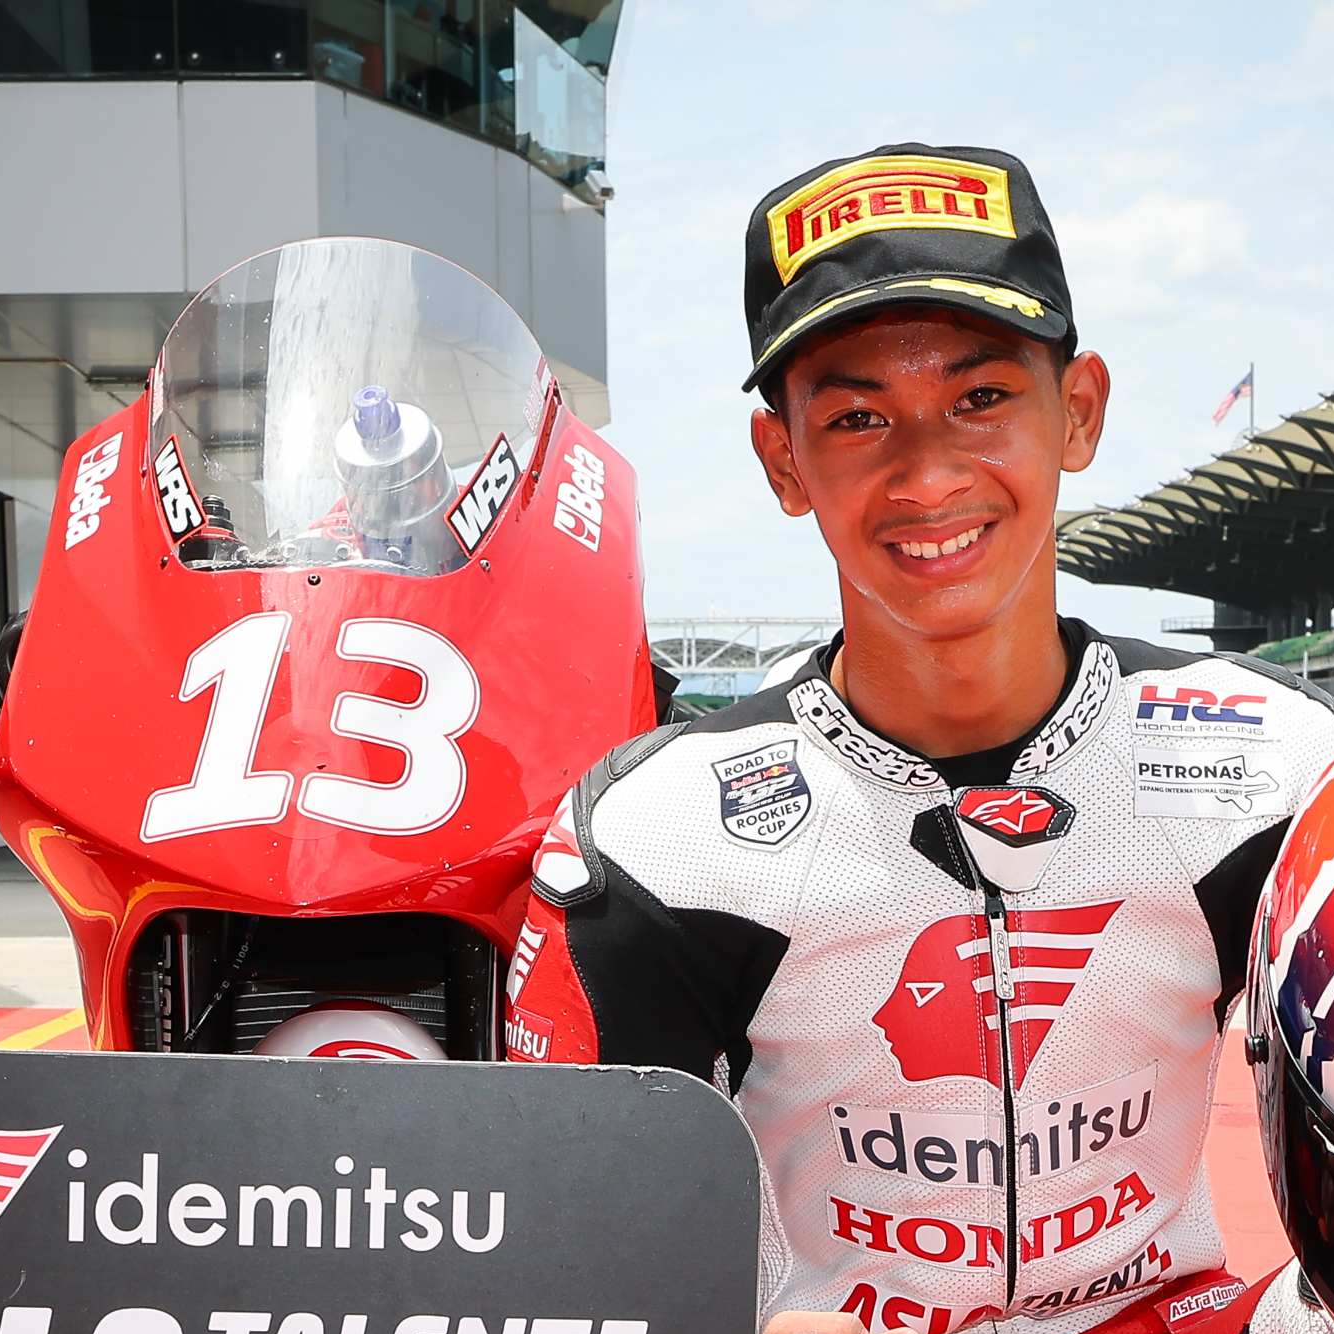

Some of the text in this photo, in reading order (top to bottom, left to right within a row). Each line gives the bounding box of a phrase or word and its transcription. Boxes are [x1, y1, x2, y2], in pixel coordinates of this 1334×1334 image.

[784, 168, 988, 258] PIRELLI
[64, 454, 120, 551] Beta
[153, 439, 203, 534] WRS
[450, 438, 516, 552] WRS
[556, 443, 606, 526] Beta
[139, 611, 482, 844] 13
[795, 679, 941, 787] alpinestars
[1012, 641, 1115, 775] alpinestars
[1135, 685, 1268, 726] HRC
[1135, 721, 1265, 737] Honda RACING
[724, 749, 788, 778] ROAD TO
[1138, 762, 1243, 780] PETRONAS
[1139, 785, 1243, 796] SEPANG INTERNATIONAL CIRCUIT
[736, 800, 802, 829] ROOKIES
[757, 820, 787, 836] CUP
[833, 1089, 1172, 1188] idemitsu
[67, 1148, 507, 1254] idemitsu
[830, 1171, 1156, 1268] HONDA
[1021, 1251, 1146, 1310] TALENT
[1171, 1283, 1247, 1321] Astra Honda
